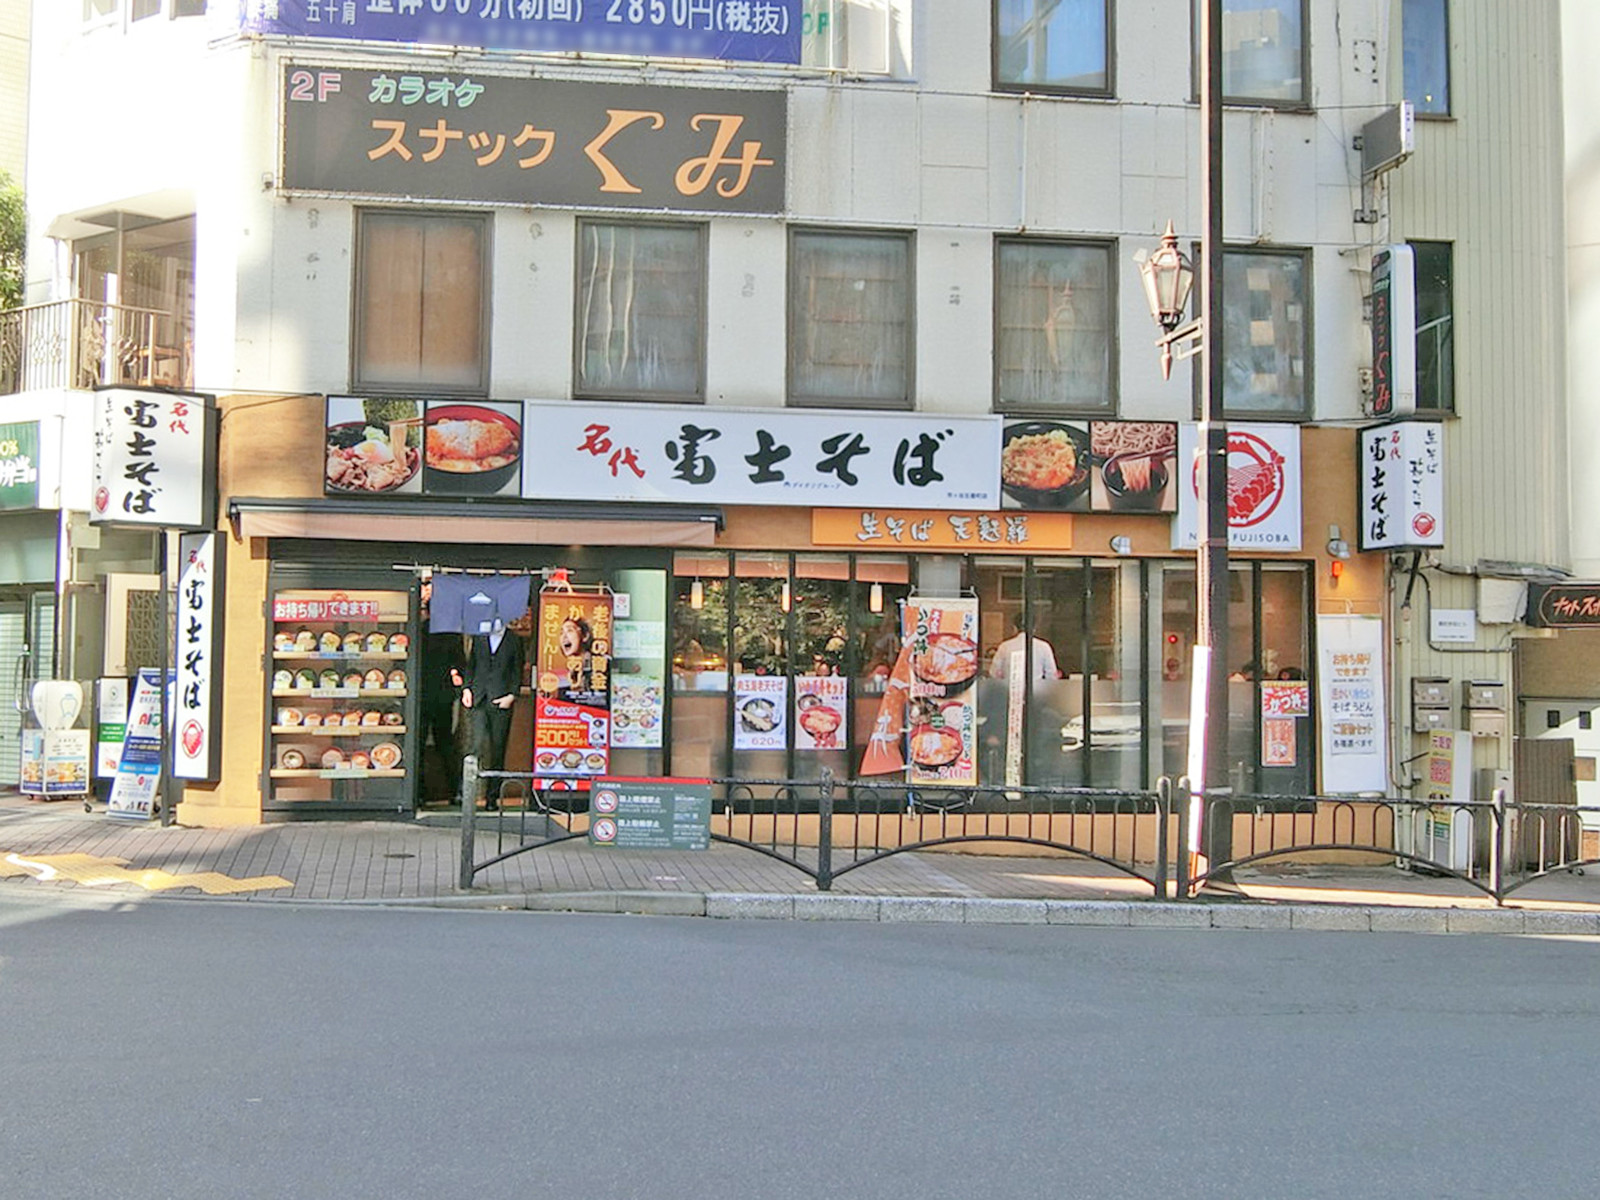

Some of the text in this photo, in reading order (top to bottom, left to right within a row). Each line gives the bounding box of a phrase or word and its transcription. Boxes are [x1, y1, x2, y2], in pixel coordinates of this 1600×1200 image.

[605, 0, 789, 35] 2850円(税抜)
[290, 71, 341, 102] 2F
[368, 74, 484, 107] カラオケ
[367, 109, 774, 198] スナック くみ
[1374, 351, 1390, 411] くみ
[169, 402, 189, 435] 名代
[122, 400, 162, 514] 富士そば
[577, 423, 954, 486] 名代 富士そば
[1390, 430, 1402, 459] 名代
[1370, 437, 1390, 541] 富士そば
[856, 511, 934, 542] 生そば
[1232, 533, 1290, 543] FUJISOBA
[188, 549, 207, 574] 名代
[183, 579, 206, 710] 富士そば
[591, 604, 609, 690] 老後の資金
[1332, 701, 1373, 713] そば うどん
